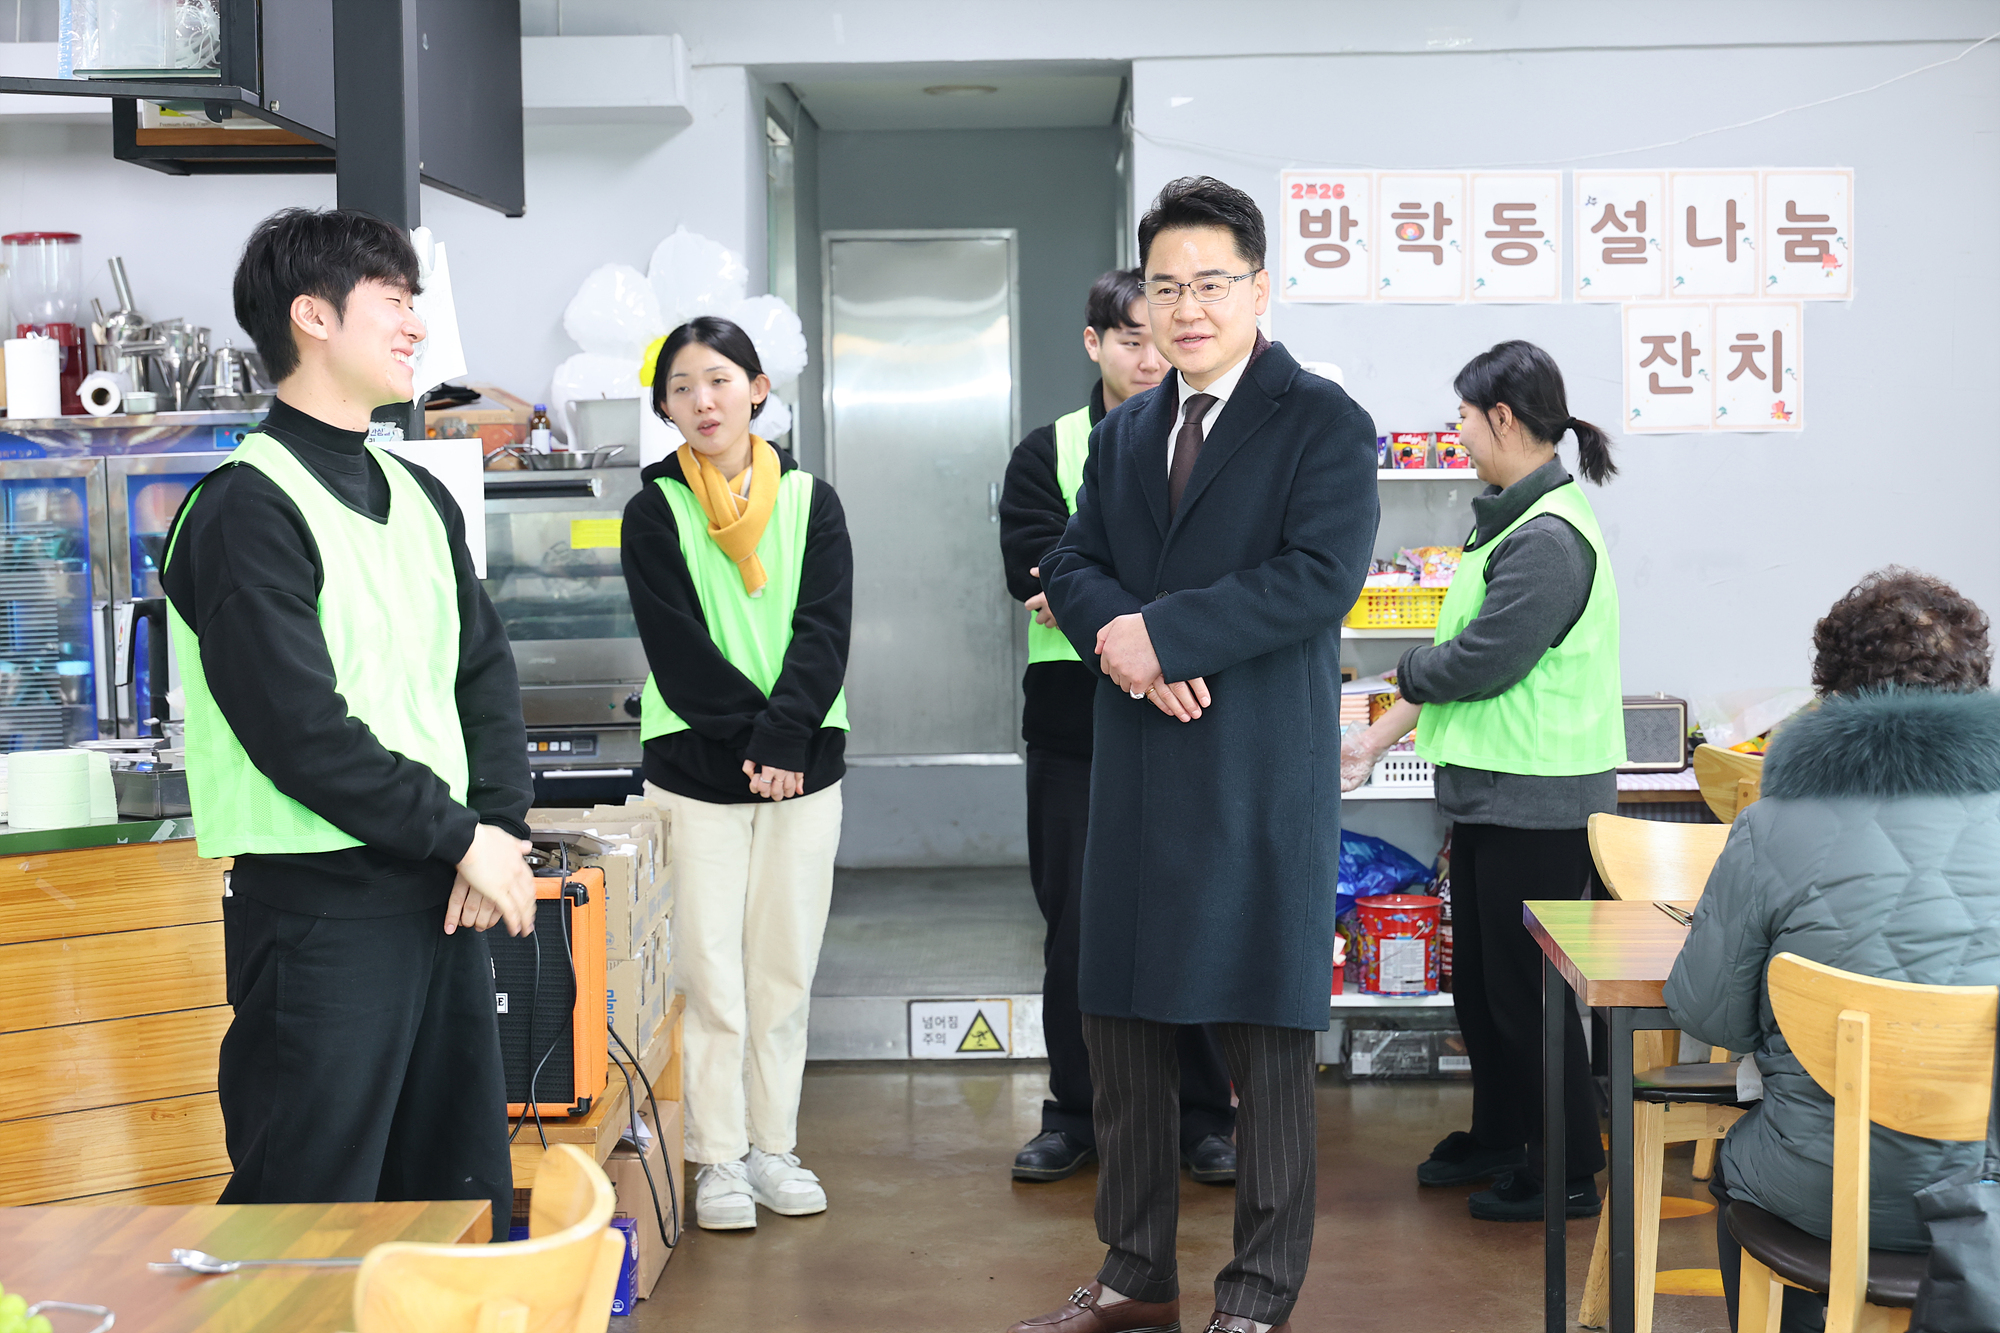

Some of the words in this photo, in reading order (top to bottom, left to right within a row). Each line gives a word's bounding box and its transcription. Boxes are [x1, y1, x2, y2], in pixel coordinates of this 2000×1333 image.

[1291, 183, 1345, 199] 2026
[1300, 201, 1544, 268] 방학동
[1591, 199, 1838, 264] 설나눔
[1640, 330, 1783, 394] 잔치
[922, 1016, 958, 1029] 넘어짐
[922, 1033, 946, 1045] 주의
